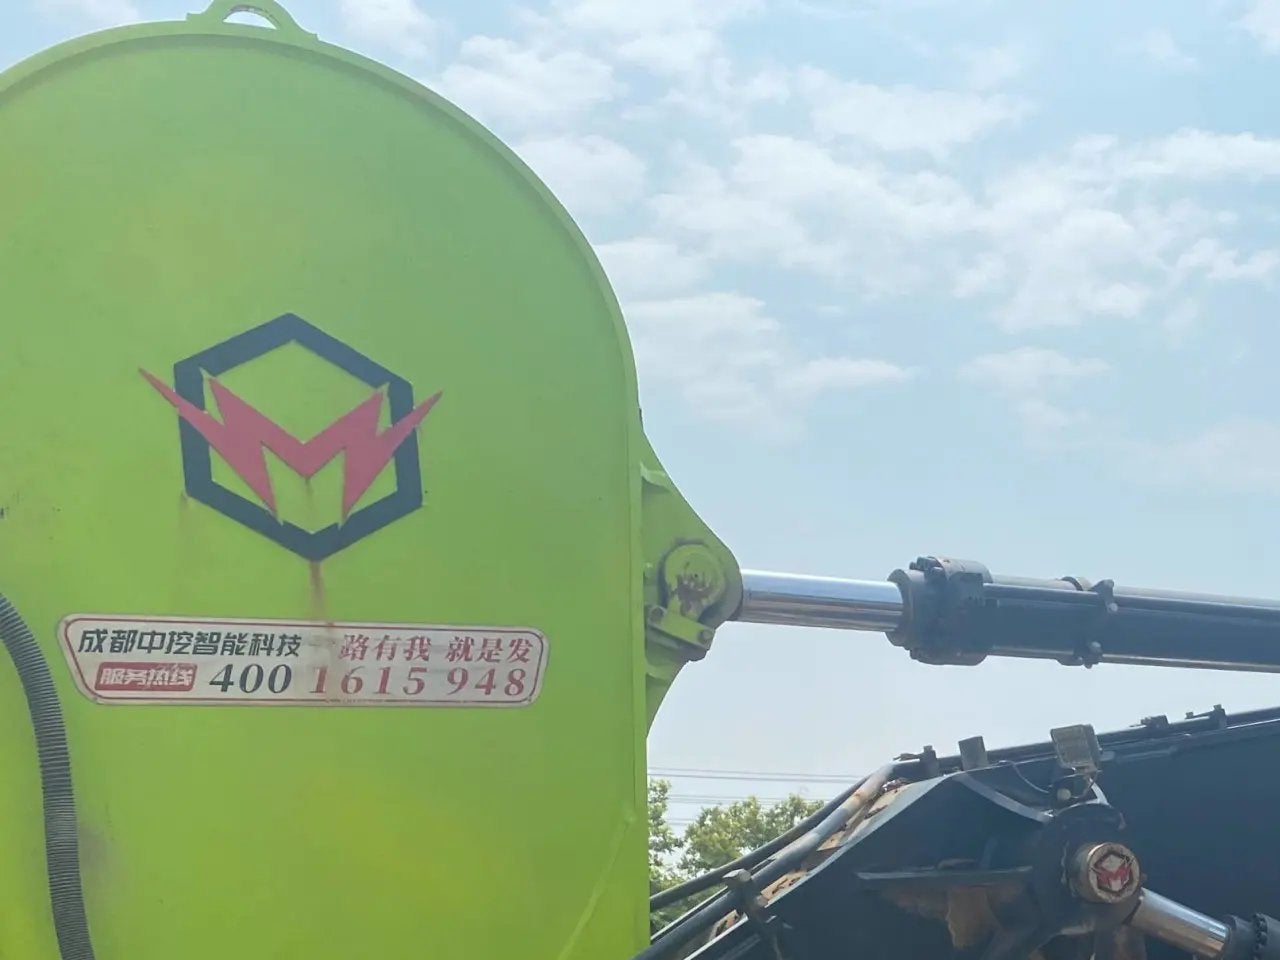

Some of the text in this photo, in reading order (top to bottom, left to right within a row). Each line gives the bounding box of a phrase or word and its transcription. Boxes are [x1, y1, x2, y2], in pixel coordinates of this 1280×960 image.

[78, 628, 302, 657] 成都中挖智能科技
[100, 663, 194, 688] 服务热线
[208, 663, 527, 697] 400 1615 948
